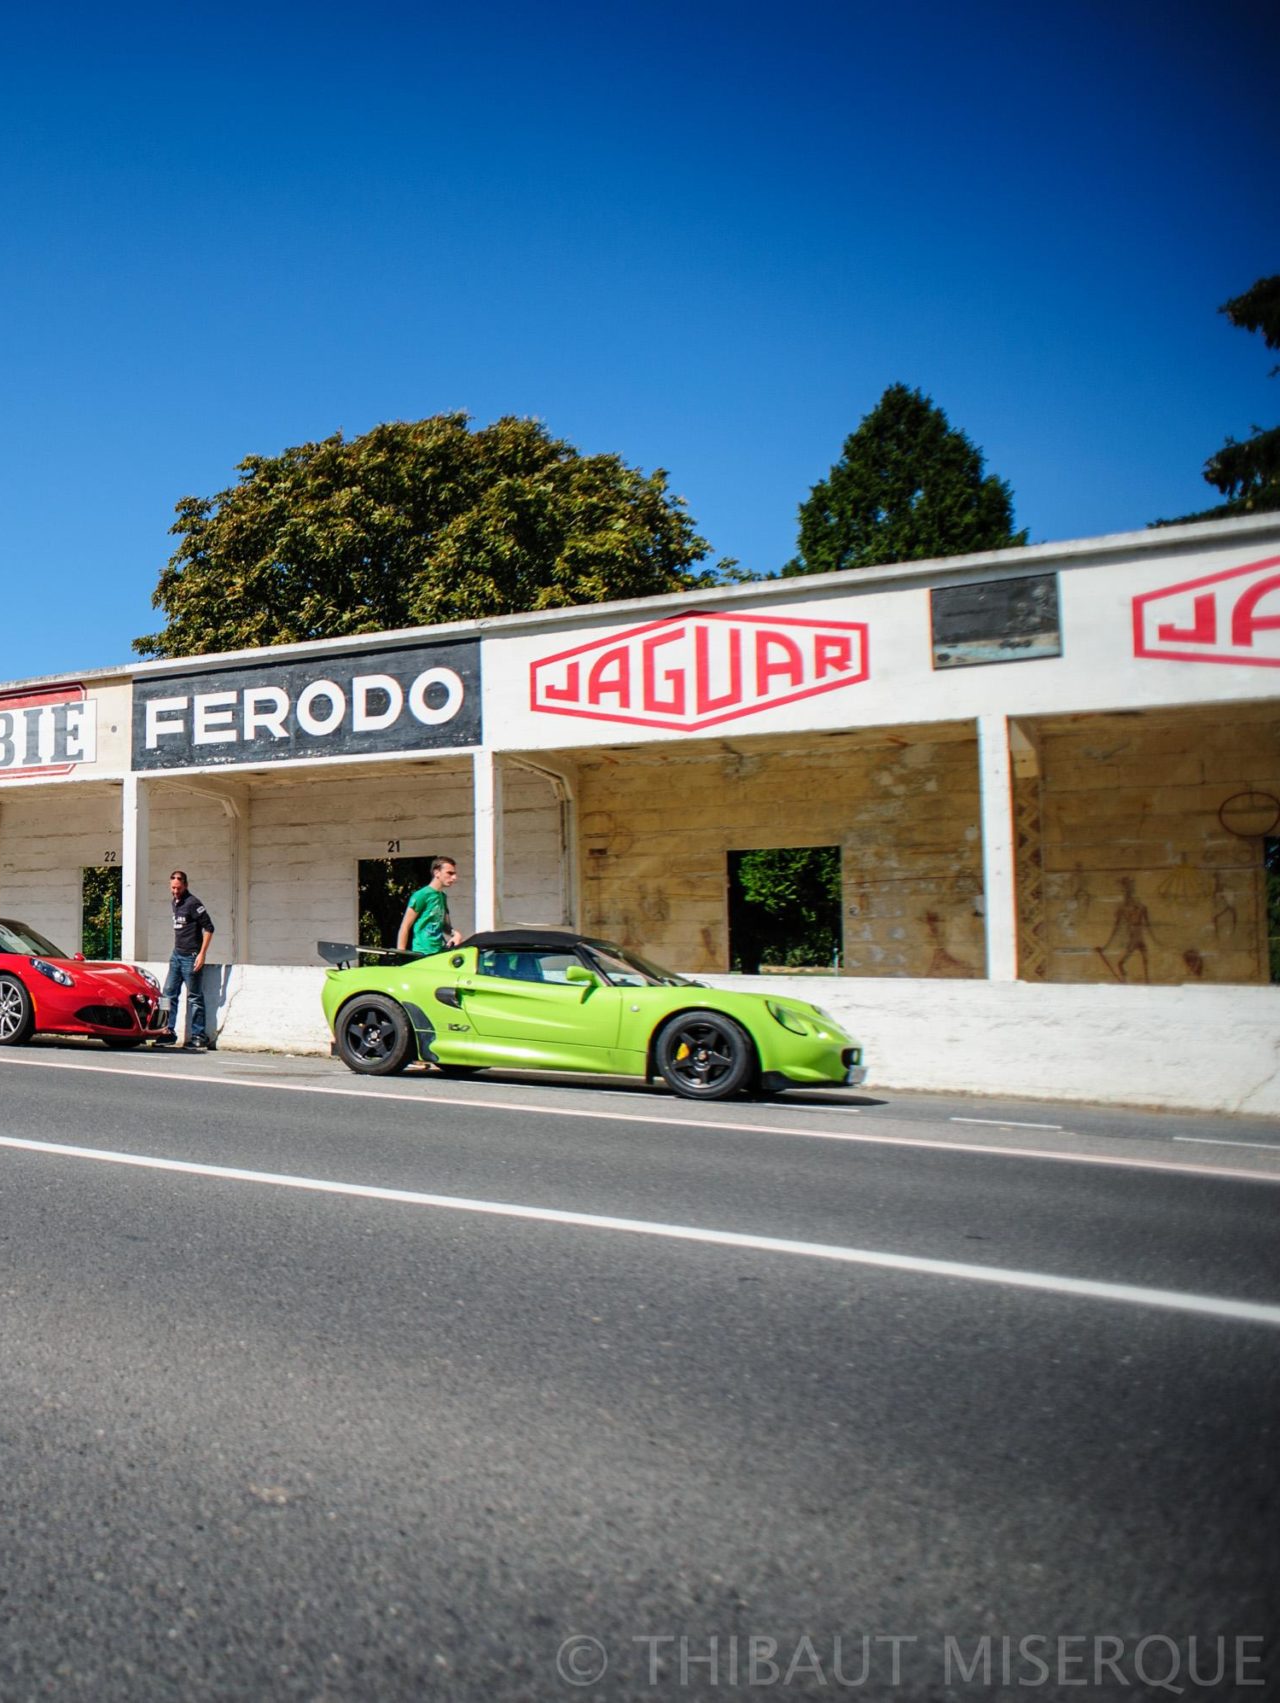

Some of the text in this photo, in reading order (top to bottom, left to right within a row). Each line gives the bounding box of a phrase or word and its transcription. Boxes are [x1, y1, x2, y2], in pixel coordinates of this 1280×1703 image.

[545, 626, 853, 715] JAGUAR
[145, 667, 464, 749] FERODO
[104, 851, 116, 862] 22
[388, 840, 400, 852] 21
